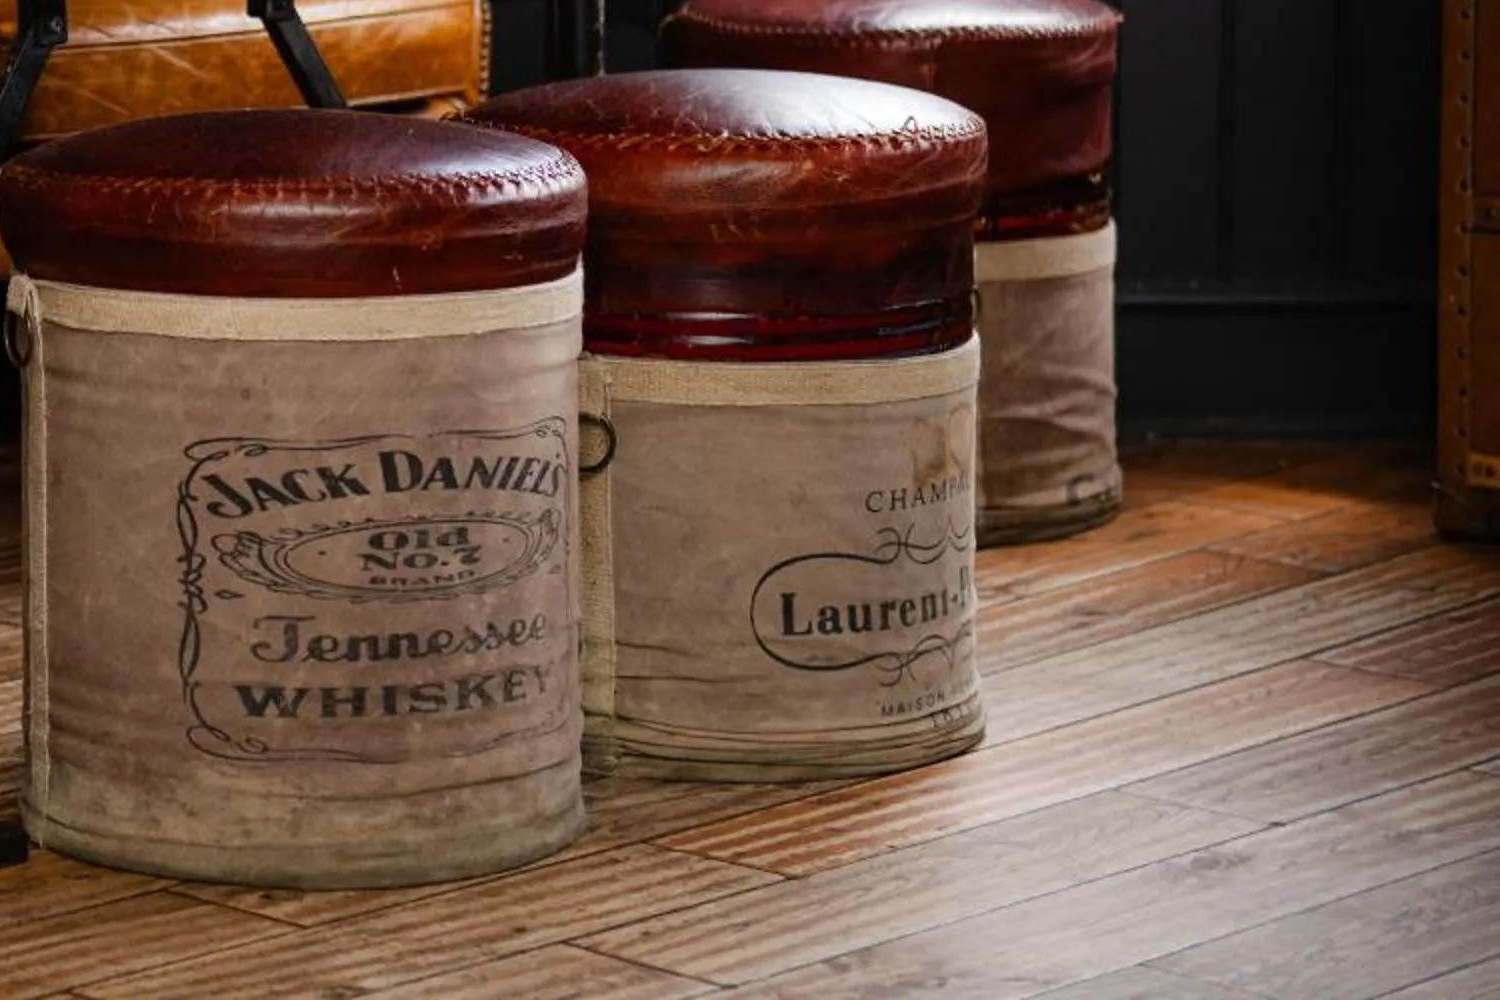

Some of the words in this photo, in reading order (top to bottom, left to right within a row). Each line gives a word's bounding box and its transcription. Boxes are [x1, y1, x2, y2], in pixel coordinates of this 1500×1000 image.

[201, 463, 370, 519] JACK
[368, 526, 470, 550] Old
[250, 613, 546, 665] Tennessee
[235, 660, 555, 720] WHISKEY
[881, 690, 946, 718] MAISON
